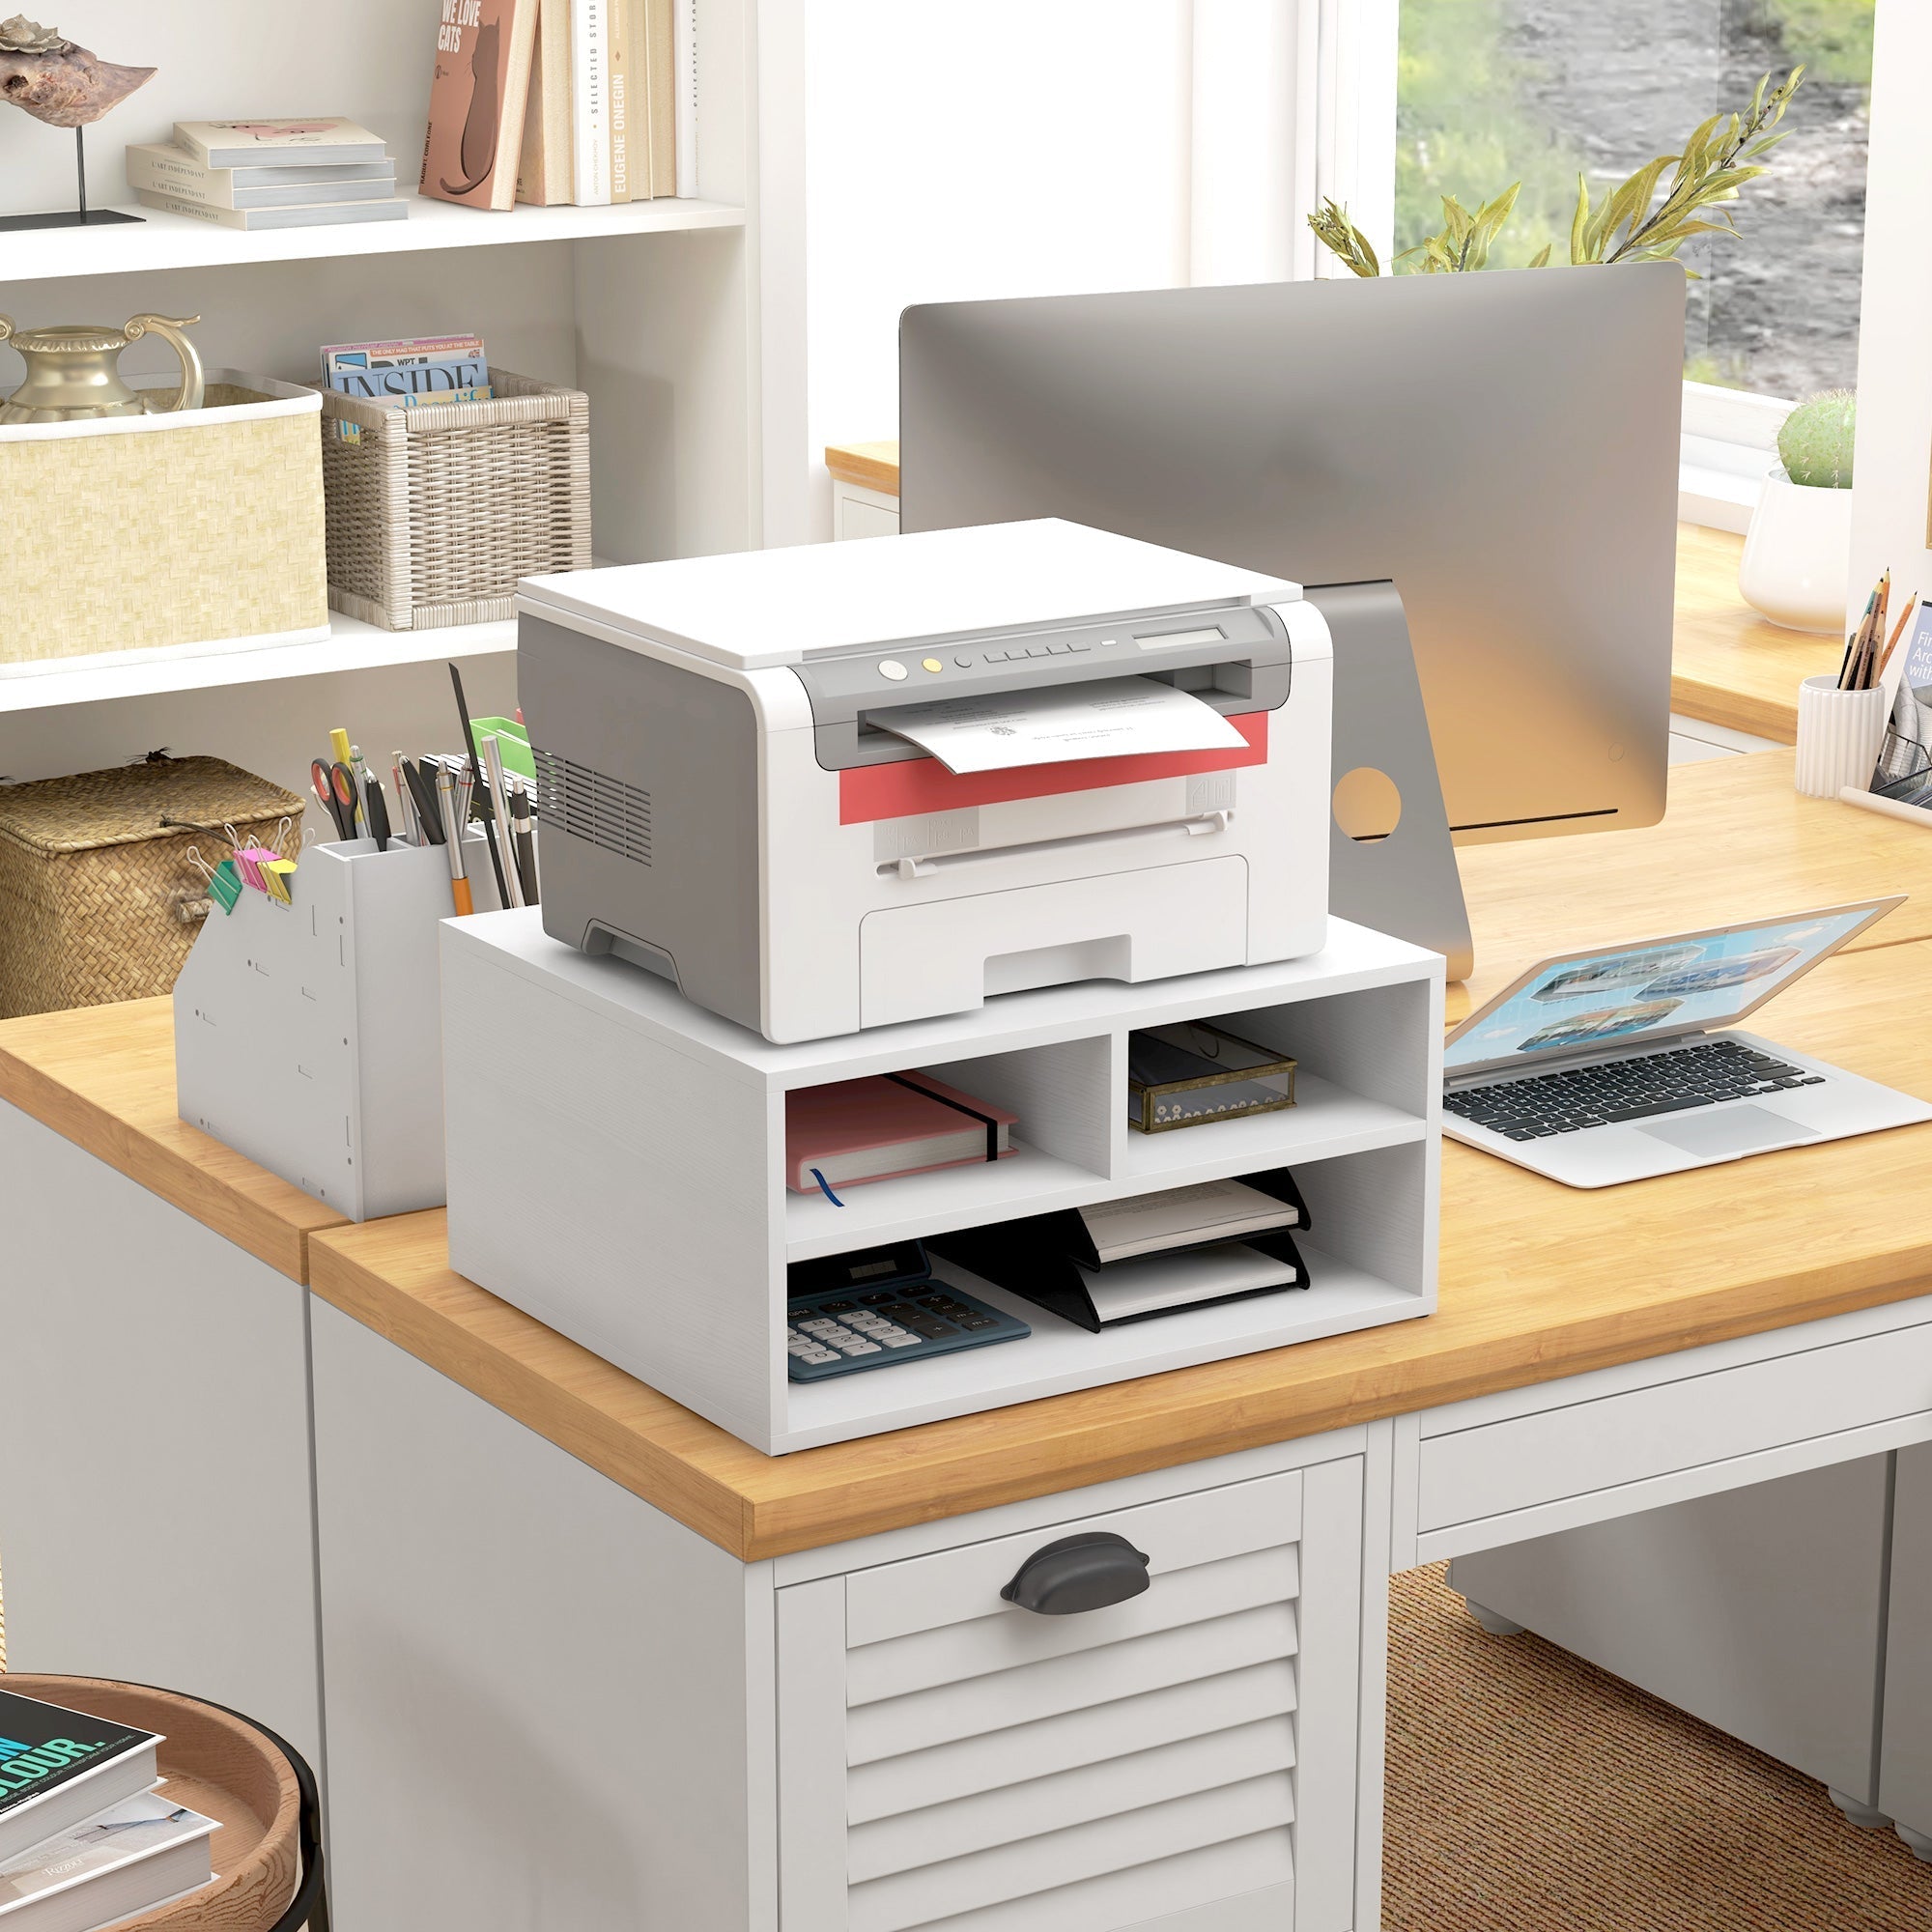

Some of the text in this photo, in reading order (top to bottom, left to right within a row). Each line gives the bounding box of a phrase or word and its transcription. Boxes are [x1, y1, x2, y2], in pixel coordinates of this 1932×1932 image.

[441, 0, 482, 28] WE LOVE
[588, 0, 597, 38] STOR
[438, 24, 462, 54] CATS
[590, 47, 599, 115] SELECTED
[612, 73, 625, 131] ONEGIN
[614, 134, 627, 193] EUGENE
[397, 357, 415, 367] WPT
[0, 1738, 106, 1798] LOUR.
